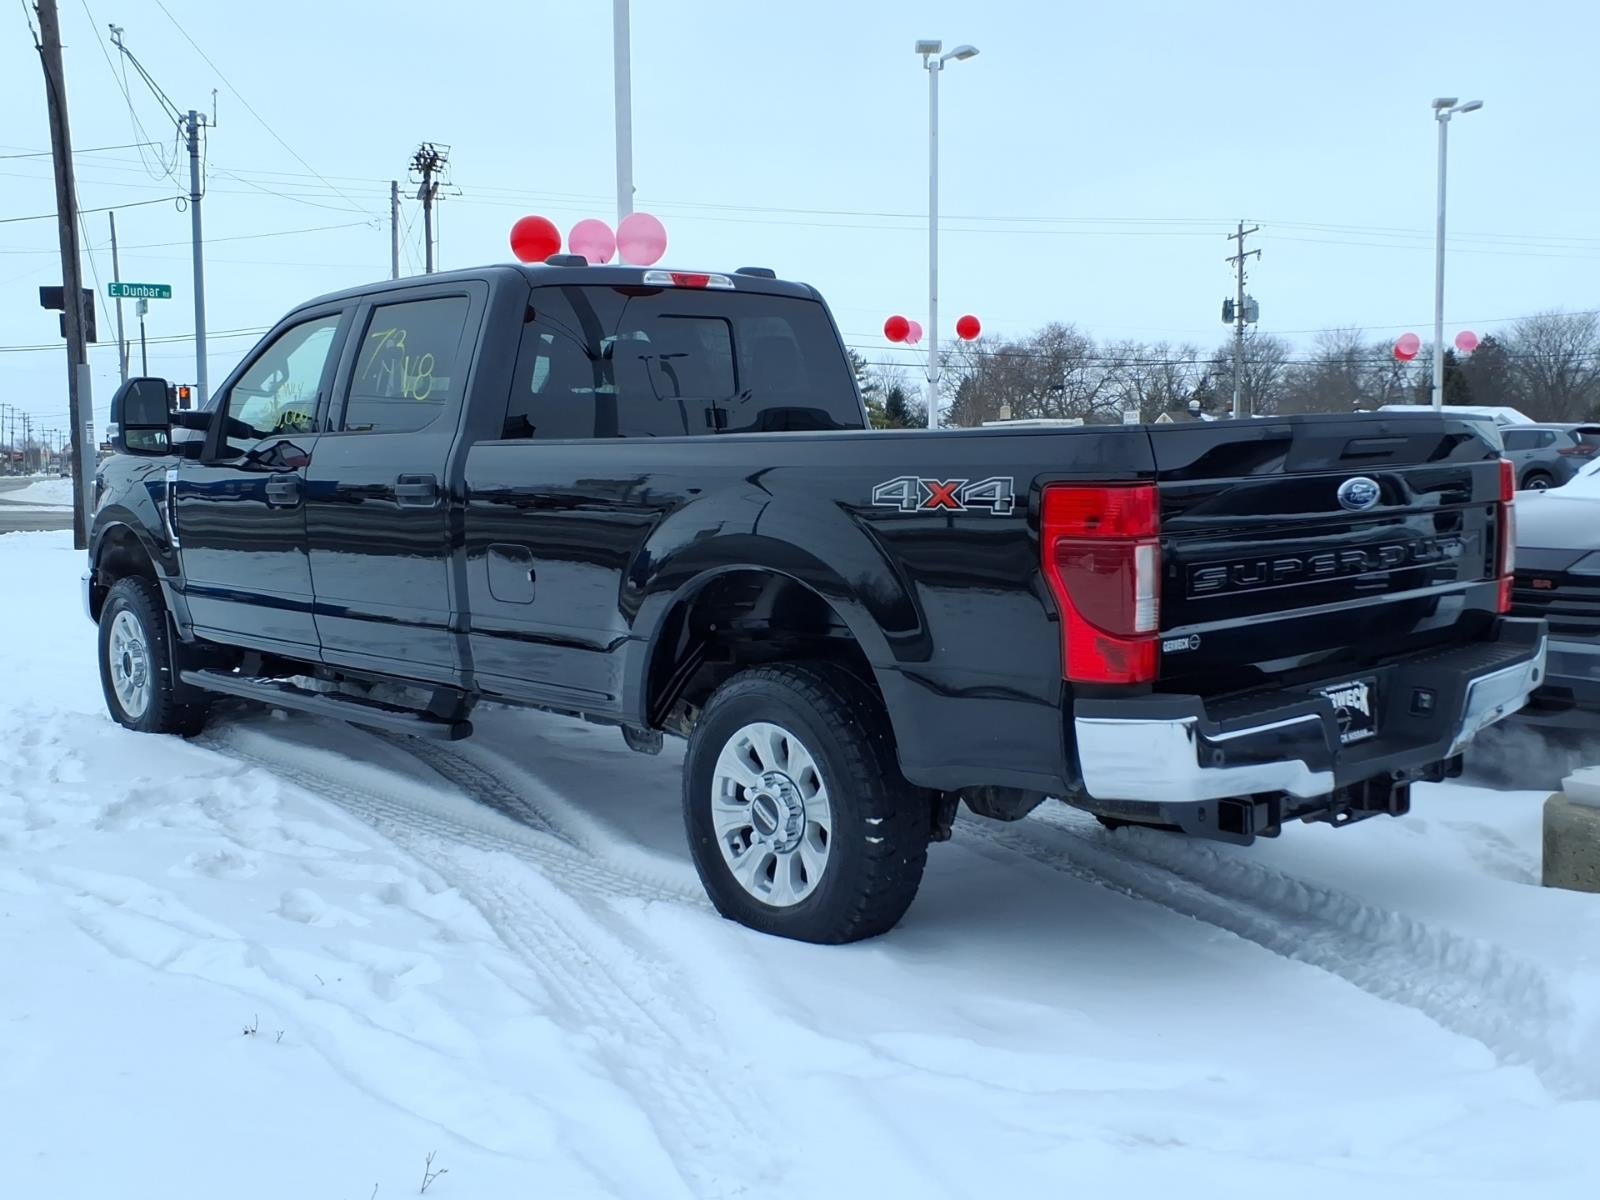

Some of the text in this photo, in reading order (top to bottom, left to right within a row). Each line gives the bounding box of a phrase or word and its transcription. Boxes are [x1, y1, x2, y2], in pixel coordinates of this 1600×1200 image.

[110, 284, 120, 296] E.
[122, 284, 160, 297] Dunbar
[1192, 550, 1369, 592] SUPER
